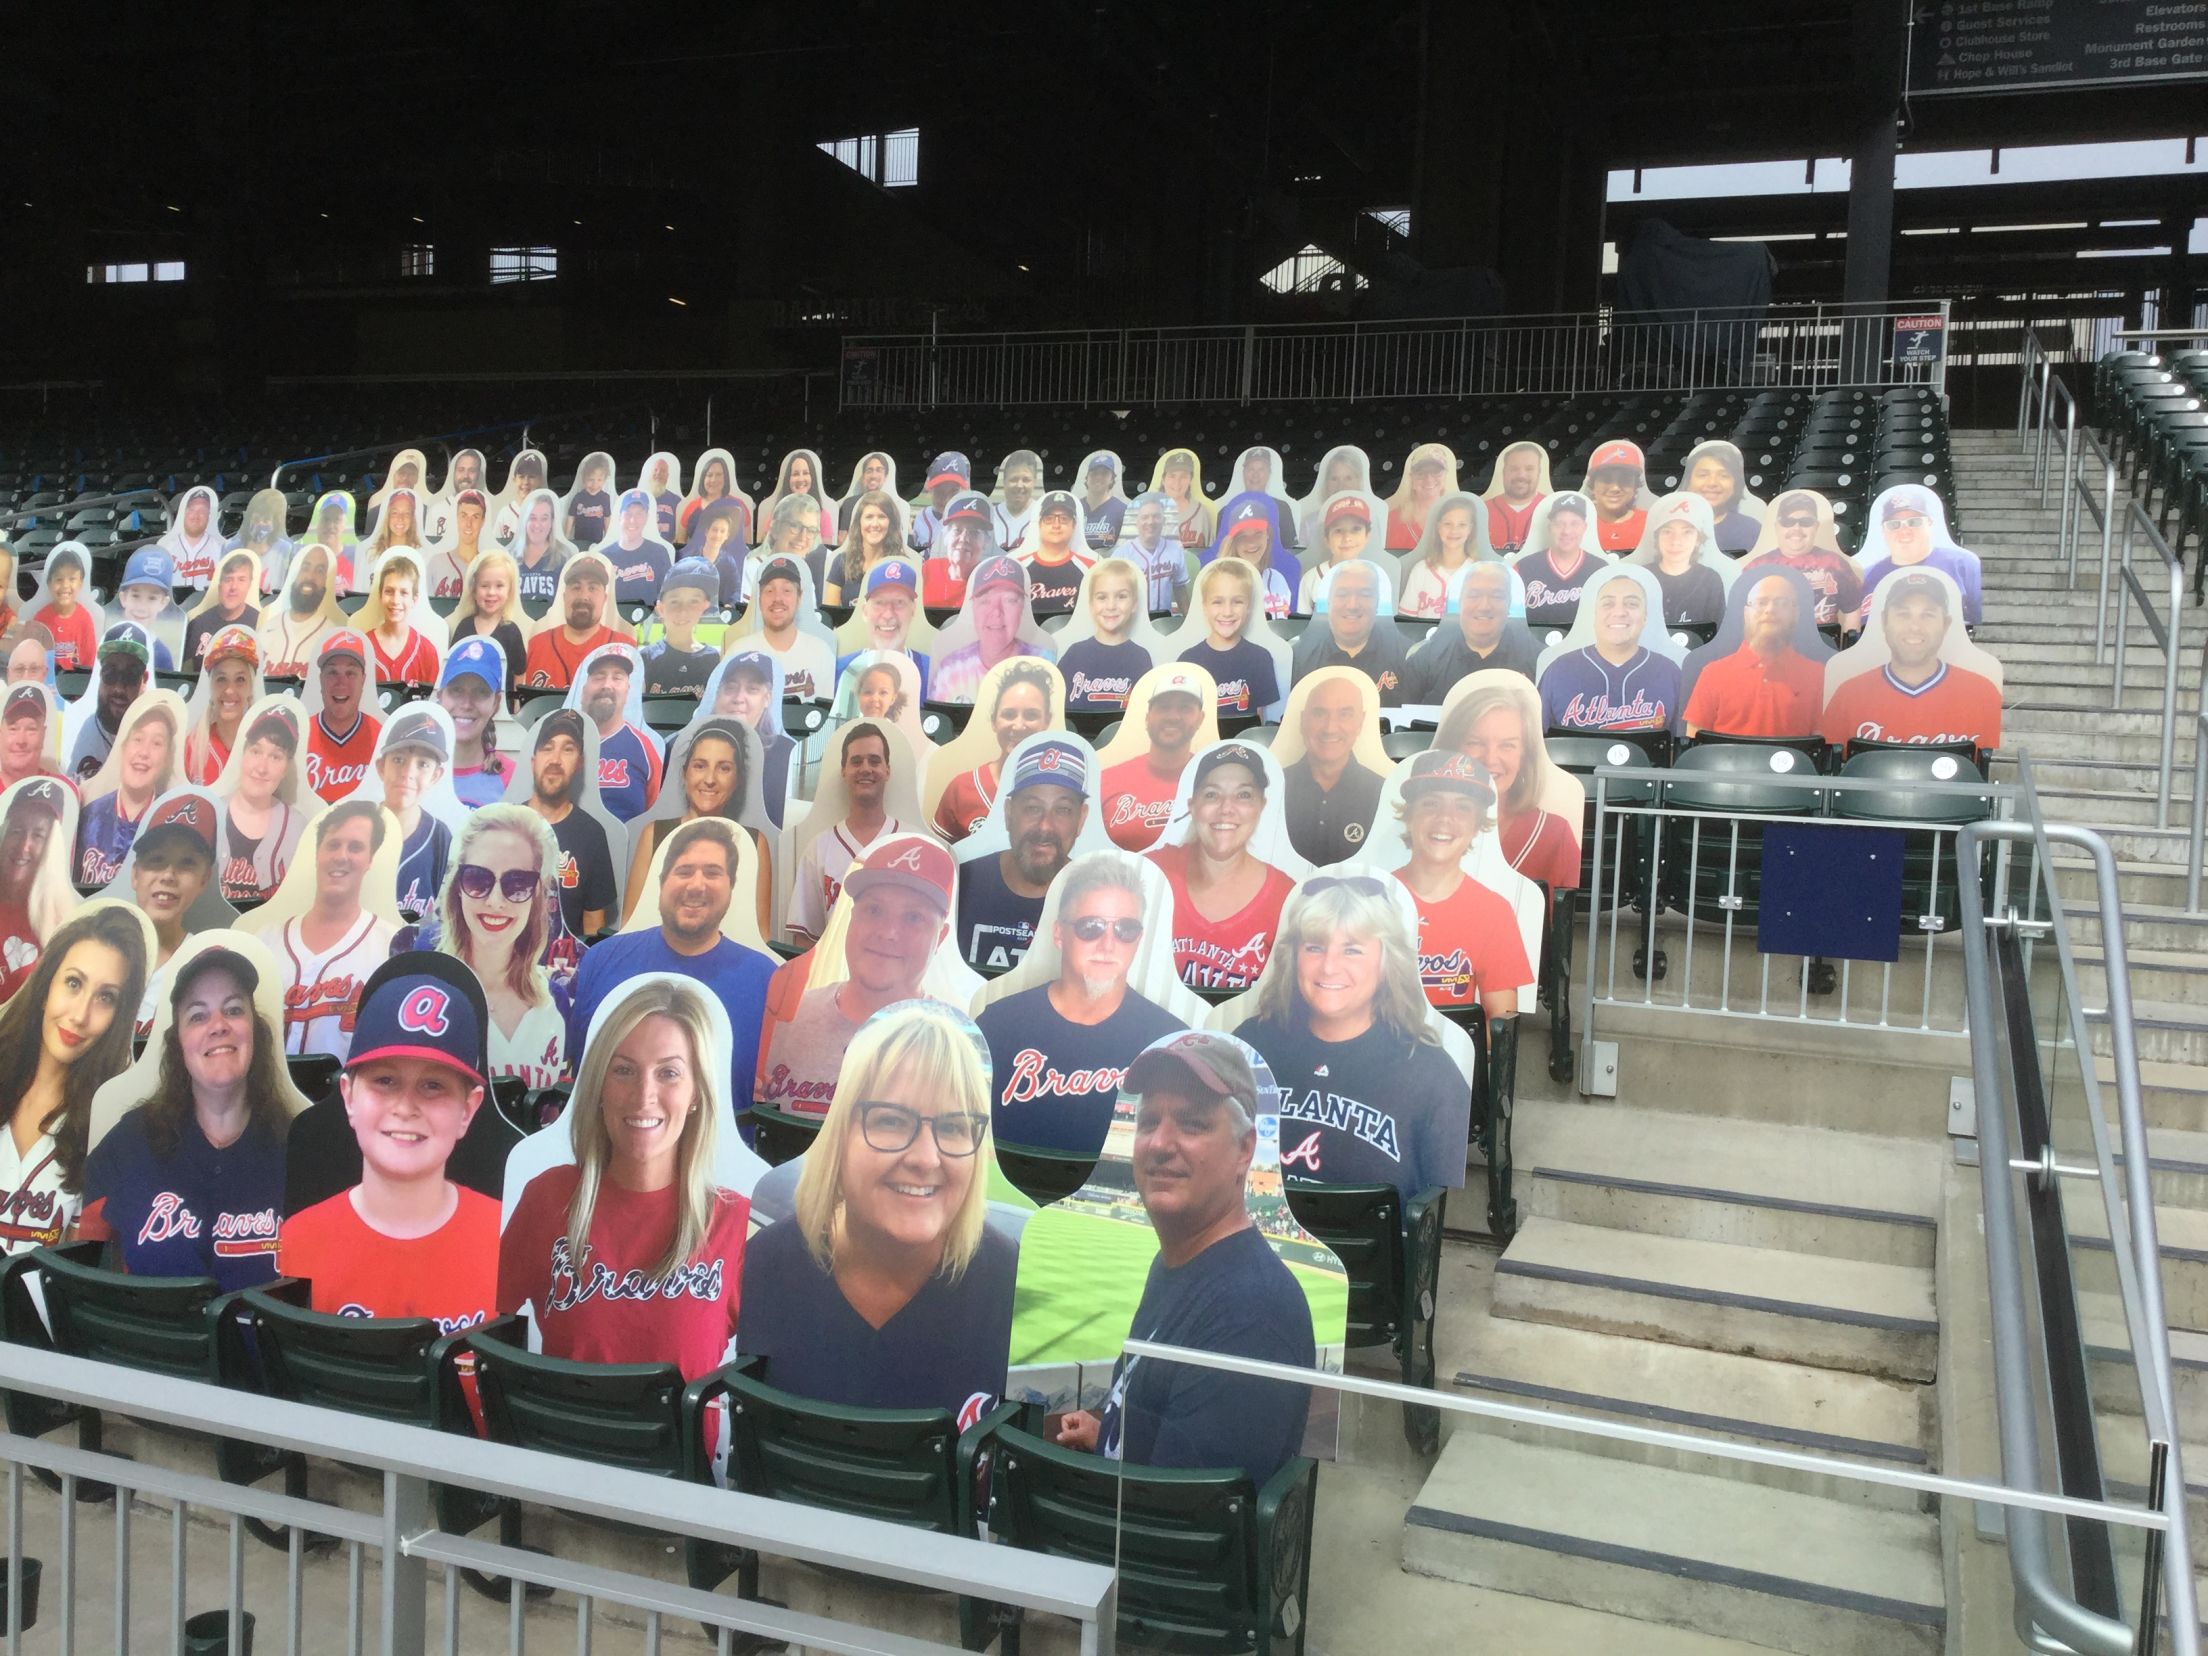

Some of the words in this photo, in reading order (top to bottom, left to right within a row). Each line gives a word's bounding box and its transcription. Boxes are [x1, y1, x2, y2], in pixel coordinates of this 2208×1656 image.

[2146, 3, 2207, 16] Elevators
[2135, 21, 2206, 33] Restrooms
[2020, 31, 2050, 42] Store
[2085, 39, 2154, 54] Monument
[2158, 36, 2204, 48] Garden
[1994, 49, 2033, 59] House
[2110, 57, 2131, 69] 3rd
[2135, 56, 2167, 67] Base
[2171, 53, 2203, 65] Gate
[1897, 319, 1942, 329] CAUTION
[1069, 671, 1132, 703] Braves
[1561, 688, 1655, 728] Atlanta
[28, 781, 51, 798] A
[165, 799, 200, 825] A
[887, 846, 922, 871] A
[541, 1035, 560, 1067] A
[1281, 1131, 1322, 1172] A
[544, 1236, 726, 1319] Braves
